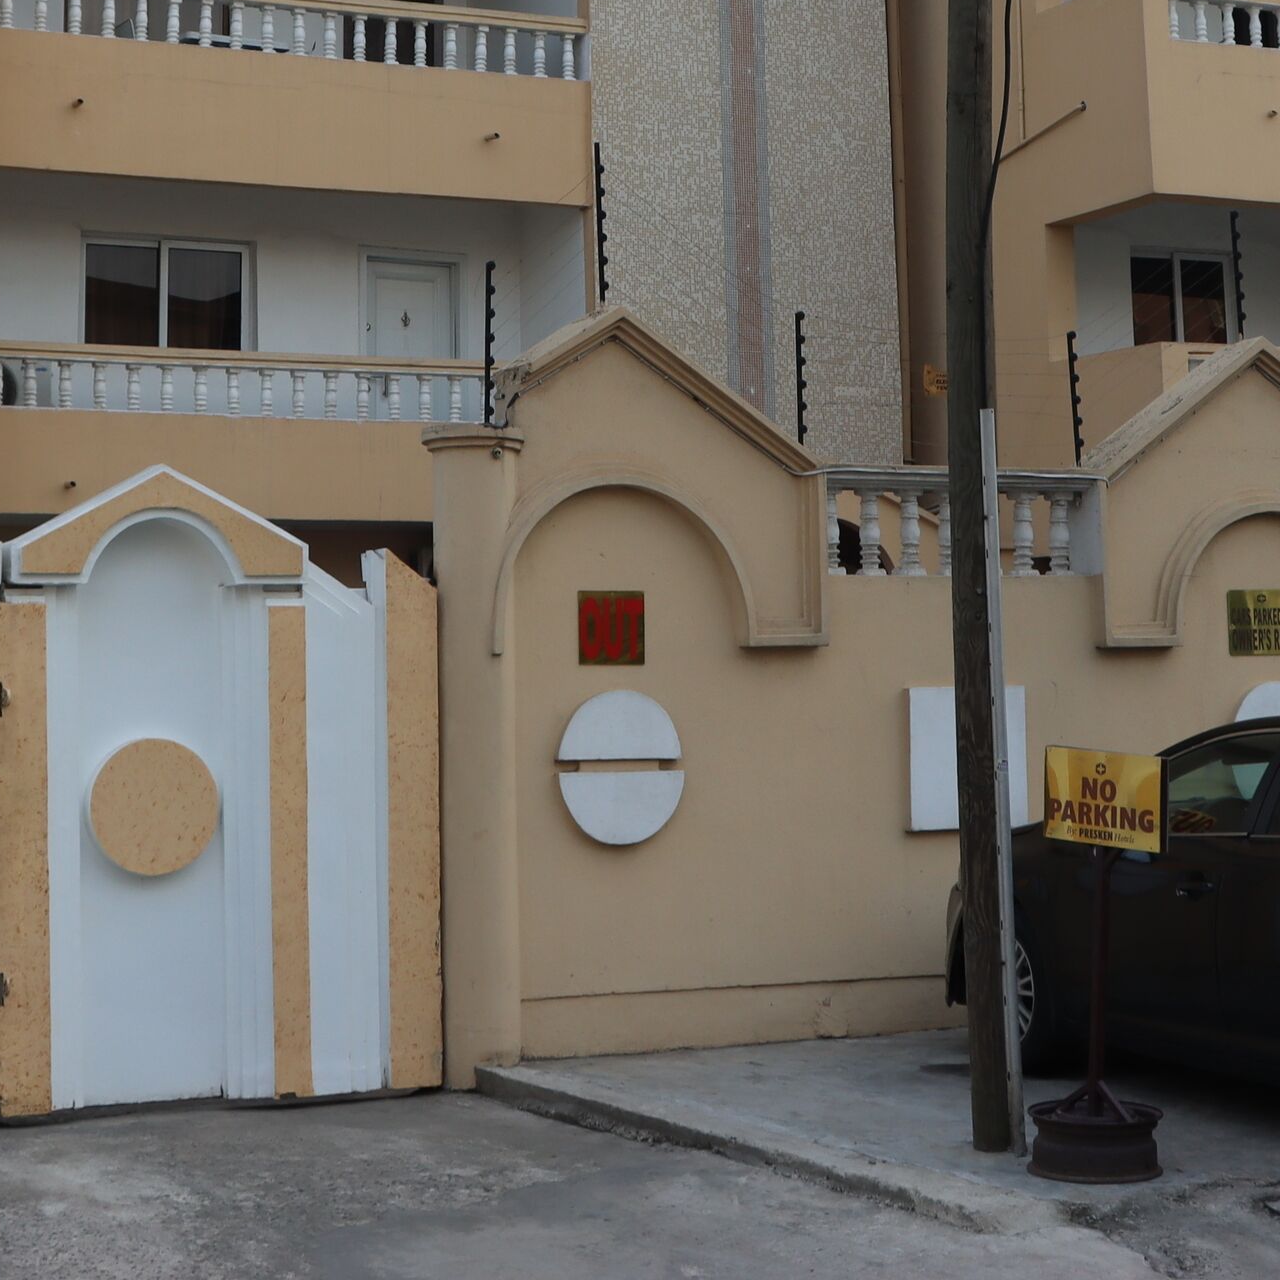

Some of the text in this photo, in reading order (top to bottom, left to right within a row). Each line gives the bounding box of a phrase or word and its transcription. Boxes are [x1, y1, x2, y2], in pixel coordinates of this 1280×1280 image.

[580, 596, 643, 661] OUT
[1231, 629, 1272, 651] OWNER'S
[1081, 776, 1117, 803] NO
[1049, 798, 1154, 833] PARKING
[1079, 829, 1113, 842] PRESKEN
